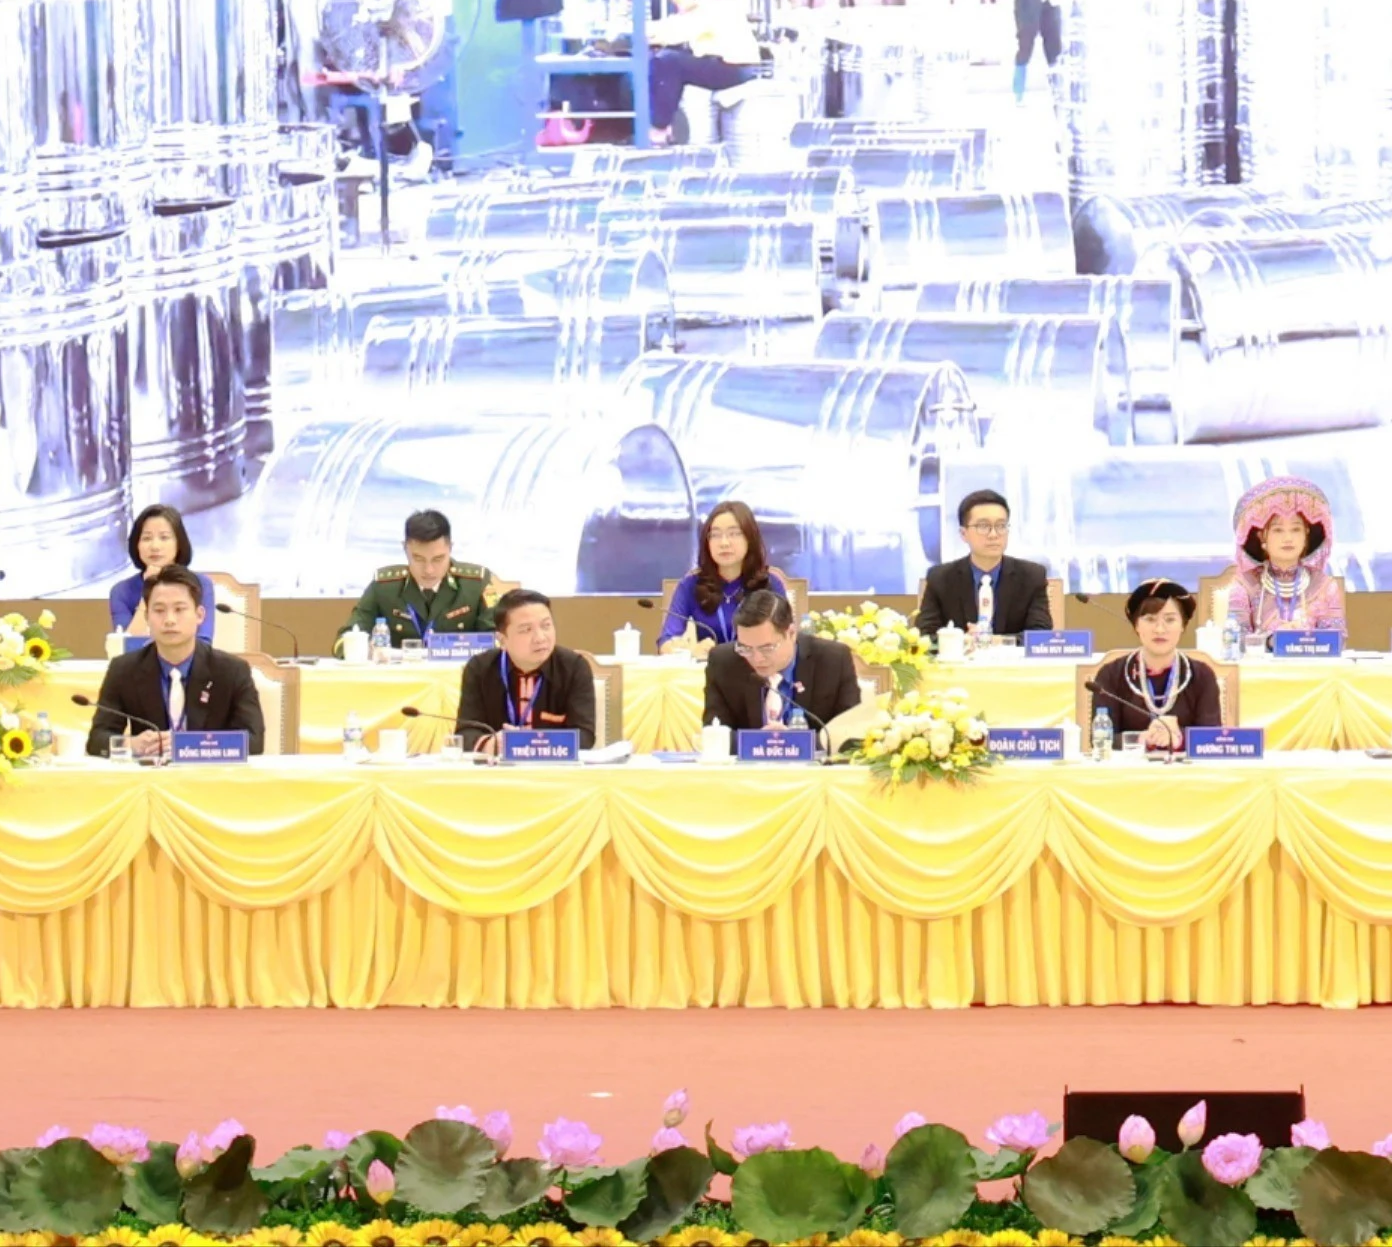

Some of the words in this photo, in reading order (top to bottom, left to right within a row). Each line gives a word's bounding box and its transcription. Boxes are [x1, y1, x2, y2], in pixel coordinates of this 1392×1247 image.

[989, 736, 1016, 752] ĐOÀN
[1017, 735, 1037, 752] CHỦ
[1038, 739, 1061, 754] TỊCH
